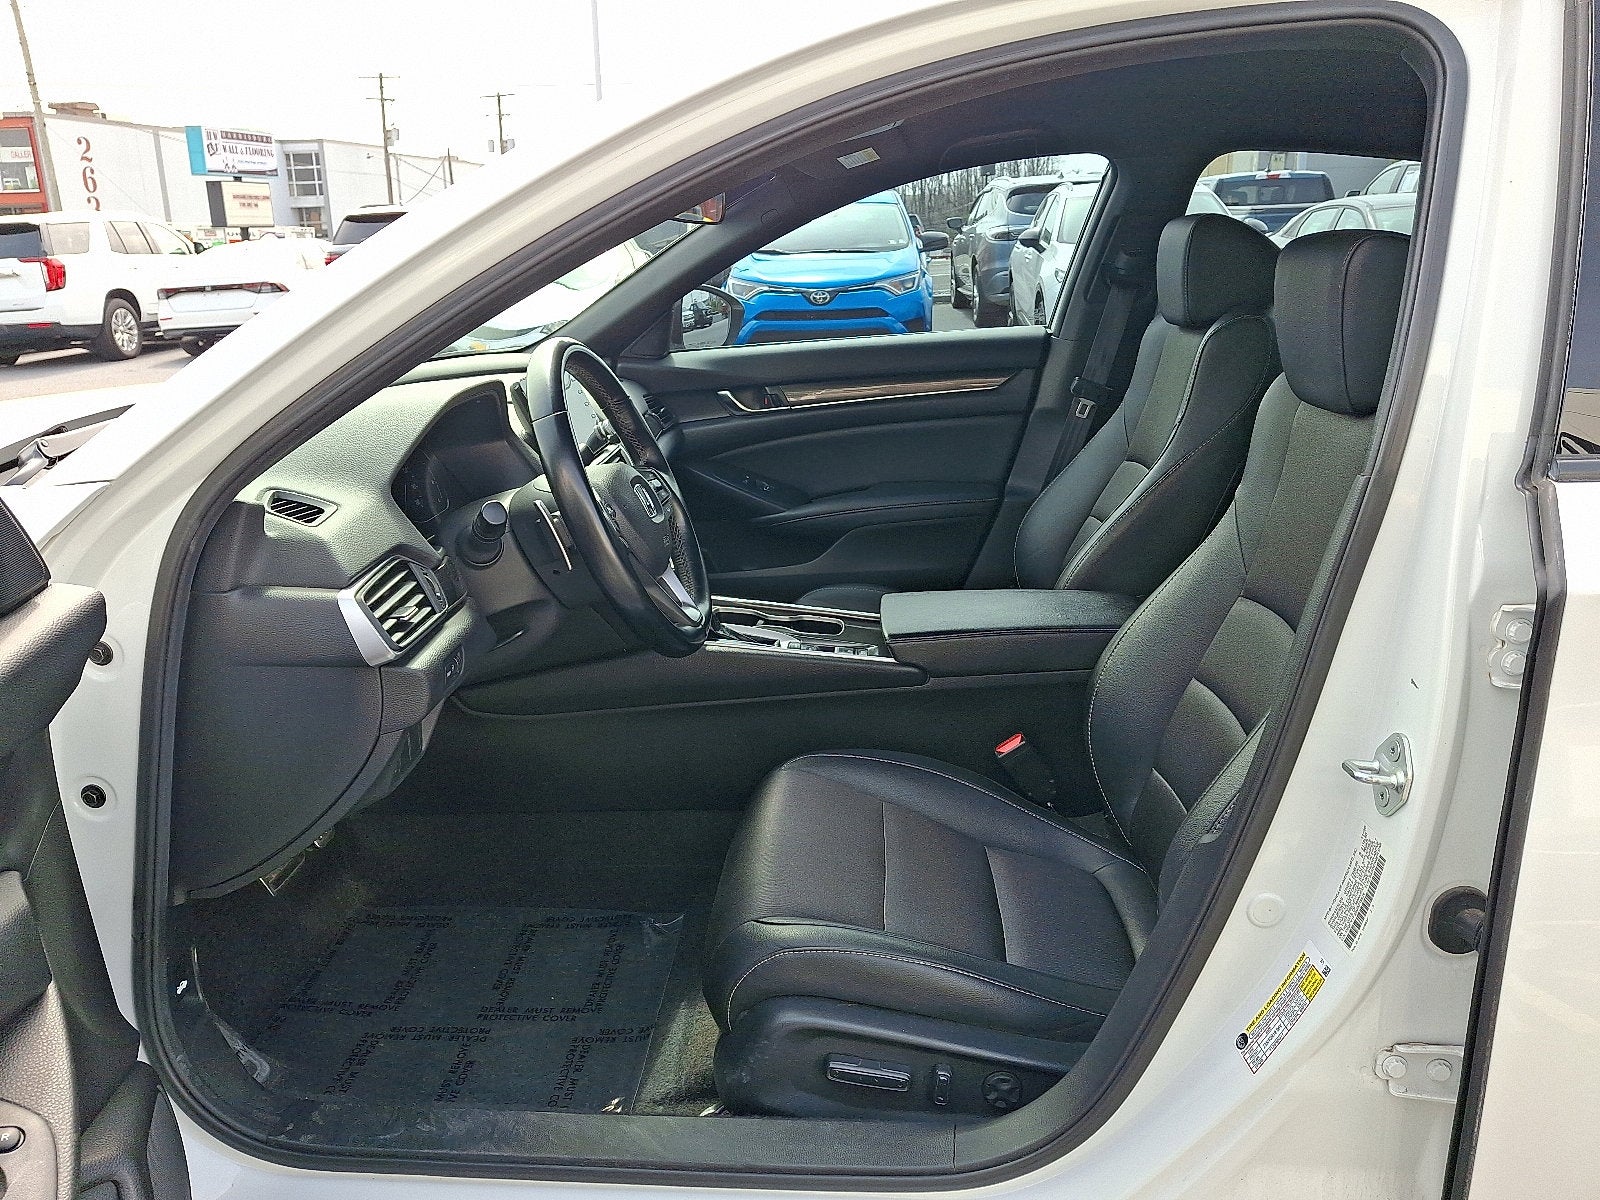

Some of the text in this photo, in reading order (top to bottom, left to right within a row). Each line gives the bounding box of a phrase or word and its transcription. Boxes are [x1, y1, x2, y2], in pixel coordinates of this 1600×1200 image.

[1255, 1010, 1265, 1020] AND
[1264, 987, 1282, 1011] LOADING
[1280, 951, 1306, 989] INFORMATION
[480, 1006, 519, 1014] DEALER
[560, 1007, 603, 1015] REMOVE
[476, 1014, 538, 1022] PROTECTIVE
[430, 1026, 492, 1034] PROTECTIVE
[599, 1028, 634, 1036] COVER
[363, 1032, 407, 1041] REMOVE
[449, 1034, 487, 1042] DEALER
[449, 1043, 471, 1074] REMOVE
[553, 1044, 576, 1091] PROTECTIVE
[455, 1060, 476, 1086] COVER
[562, 1044, 591, 1101] DEALER MUST
[1, 1133, 10, 1141] R
